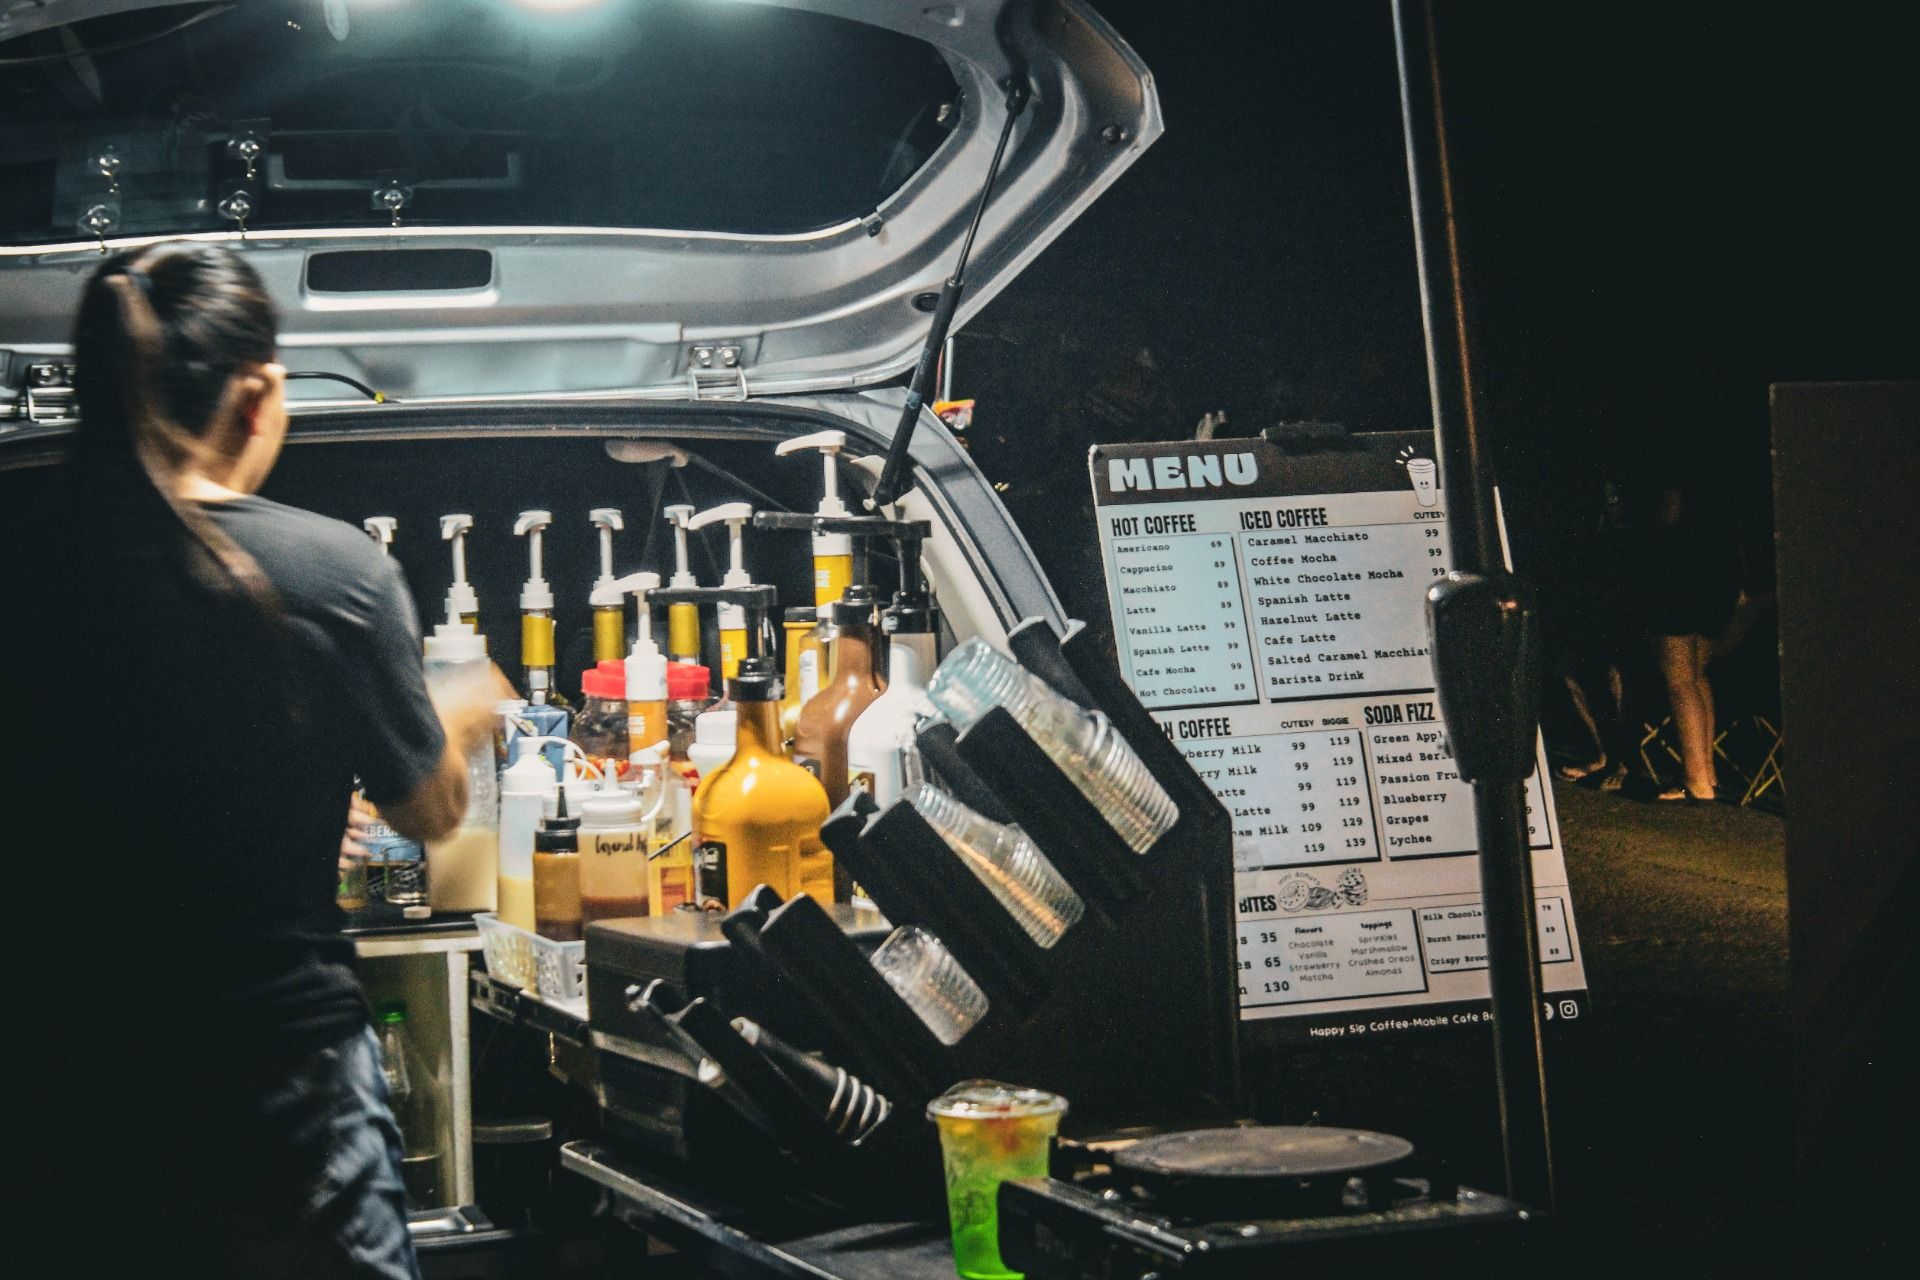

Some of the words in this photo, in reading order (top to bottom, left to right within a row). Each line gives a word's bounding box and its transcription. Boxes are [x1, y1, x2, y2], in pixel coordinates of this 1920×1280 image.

[1108, 452, 1259, 493] MENU
[1239, 510, 1273, 530] ICED
[1276, 507, 1328, 528] COFFEE
[1111, 517, 1139, 536] HOT
[1144, 514, 1197, 535] COFFEE
[1425, 529, 1439, 537] 99
[1248, 535, 1298, 546] Caramel
[1305, 532, 1369, 543] Macchiato
[1117, 544, 1170, 553] Americano
[1428, 548, 1442, 557] 99
[1251, 556, 1294, 566] Coffee
[1301, 553, 1337, 564] Mocha
[1120, 564, 1173, 575] Cappucino
[1431, 567, 1446, 576] 99
[1254, 576, 1290, 586] White
[1298, 572, 1361, 583] Chocolate
[1368, 569, 1404, 580] Mocha
[1123, 584, 1176, 594] Macchiato
[1258, 594, 1308, 607] Spanish
[1315, 593, 1350, 602] Latte
[1126, 607, 1156, 615] Latte
[1261, 614, 1318, 625] Hazelnut
[1326, 611, 1361, 622] Latte
[1129, 626, 1171, 635] Vanilla
[1177, 624, 1206, 632] Latte
[1224, 622, 1235, 630] 99
[1264, 636, 1293, 645] Cafe
[1300, 633, 1336, 643] Latte
[1133, 647, 1175, 657] Spanish
[1181, 644, 1210, 653] Latte
[1227, 642, 1239, 650] 99
[1268, 653, 1311, 665] Salted
[1318, 650, 1368, 662] Caramel
[1375, 646, 1432, 659] Macchiat
[1136, 668, 1160, 677] Cafe
[1166, 666, 1196, 675] Mocha
[1271, 674, 1322, 685] Barista
[1328, 671, 1365, 681] Drink
[1140, 689, 1157, 697] Hot
[1163, 686, 1217, 695] Chocolate
[1364, 704, 1403, 724] SODA
[1406, 702, 1435, 722] FIZZ
[1280, 719, 1314, 728] CUTESY
[1322, 717, 1350, 726] BIGGIE
[1179, 717, 1232, 739] COFFEE
[1330, 737, 1350, 746] 119
[1374, 735, 1410, 744] Green
[1232, 745, 1261, 755] Milk
[1291, 742, 1306, 750] 99
[1333, 757, 1353, 766] 119
[1377, 753, 1413, 764] Mixed
[1228, 766, 1258, 776] Milk
[1295, 762, 1309, 771] 99
[1336, 777, 1357, 786] 119
[1380, 774, 1430, 785] Passion
[1298, 782, 1312, 791] 99
[1339, 797, 1360, 806] 119
[1384, 792, 1447, 805] Blueberry
[1235, 806, 1271, 817] Latte
[1301, 803, 1315, 812] 99
[1342, 817, 1363, 827] 129
[1386, 815, 1429, 827] Grapes
[1259, 826, 1289, 836] Milk
[1301, 823, 1322, 832] 109
[1346, 838, 1366, 847] 139
[1390, 835, 1432, 847] Lychee
[1304, 843, 1325, 853] 119
[1239, 895, 1277, 913] BITES
[1447, 910, 1483, 919] Chocola
[1261, 932, 1277, 943] 35
[1358, 933, 1398, 944] Sprinkles
[1289, 939, 1334, 949] Chocolate
[1351, 945, 1408, 956] Marshmallow
[1264, 956, 1281, 967] 65
[1289, 961, 1341, 973] Strawberry
[1349, 957, 1385, 968] Crushed
[1299, 973, 1334, 982] Matcha
[1365, 967, 1402, 977] Almonds
[1264, 981, 1290, 993] 130
[1310, 1026, 1345, 1038] Happy
[1350, 1024, 1366, 1034] Sip
[1370, 1015, 1448, 1032] Coffee-Mobile
[1452, 1013, 1479, 1024] Cafe
